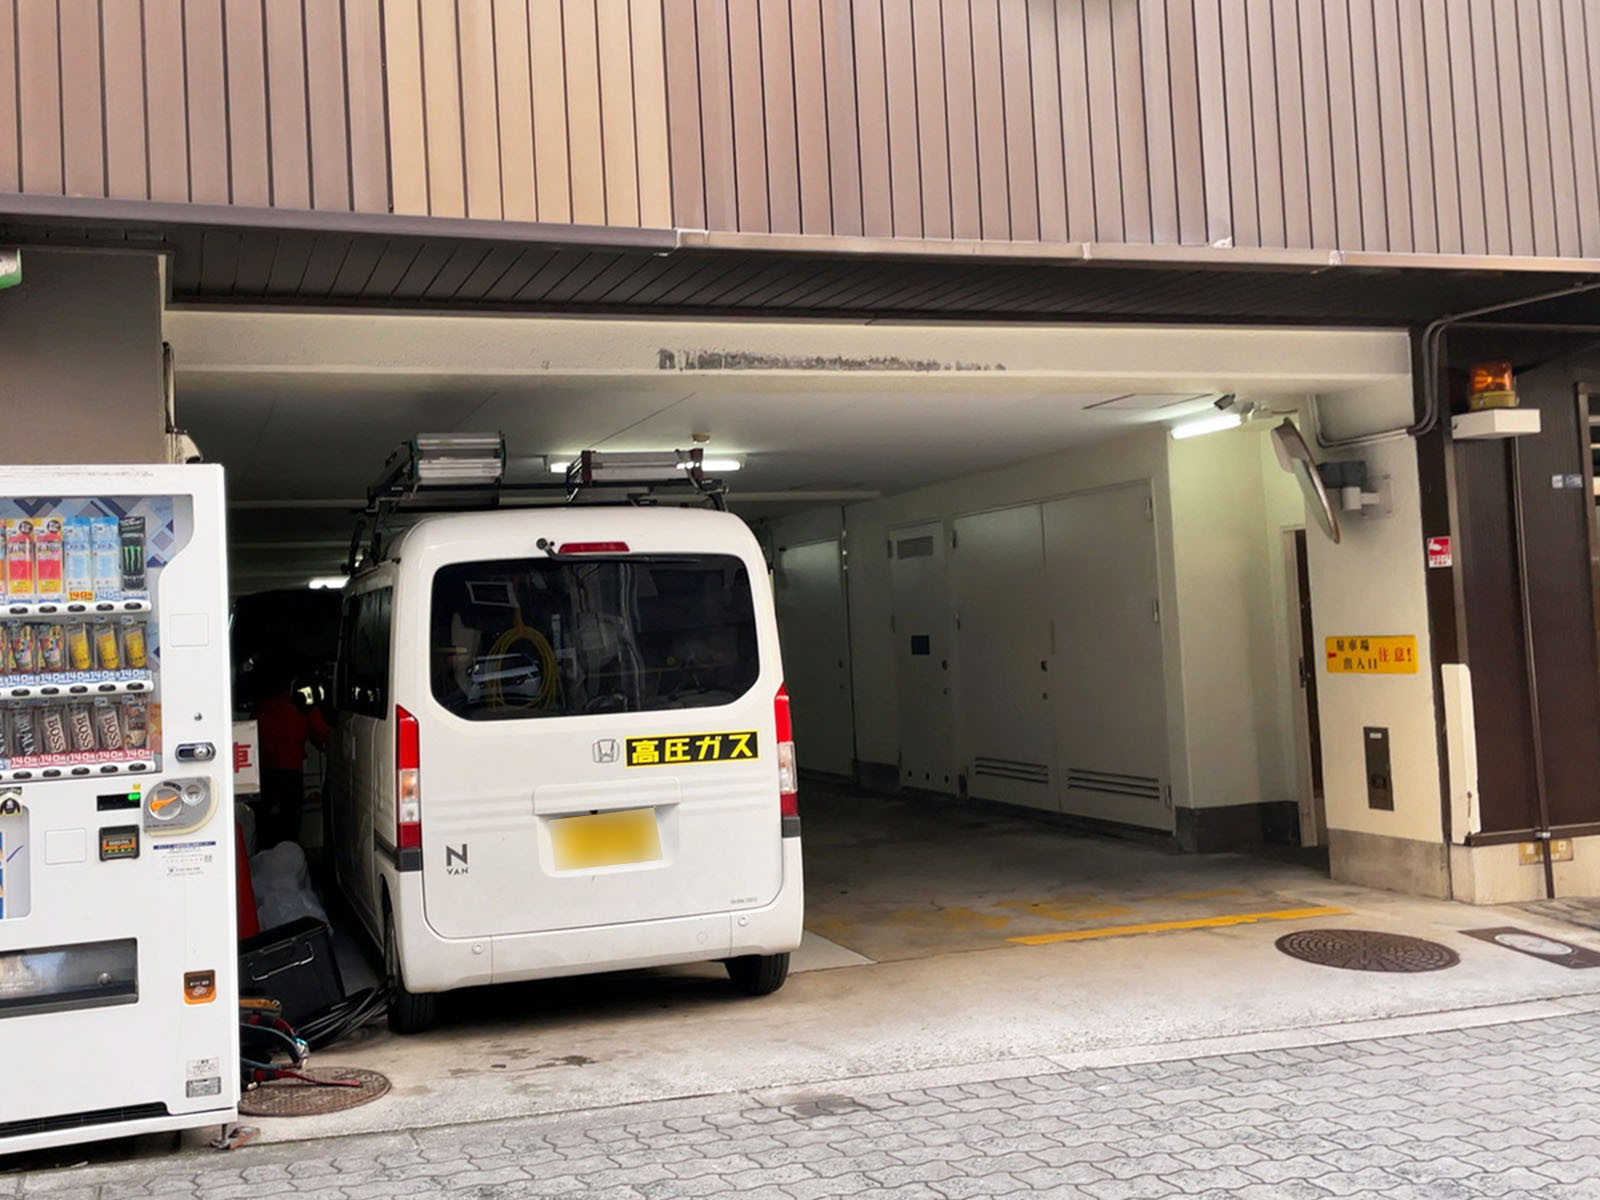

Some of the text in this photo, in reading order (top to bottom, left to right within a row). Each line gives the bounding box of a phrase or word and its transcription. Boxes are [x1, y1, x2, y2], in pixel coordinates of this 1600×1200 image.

[1336, 639, 1369, 651] 駐車場
[48, 718, 63, 751] BOSS
[77, 716, 90, 748] BOSS
[104, 715, 119, 748] BOSS
[631, 733, 753, 764] 高圧ガス
[446, 843, 468, 866] N
[446, 867, 469, 875] VAN
